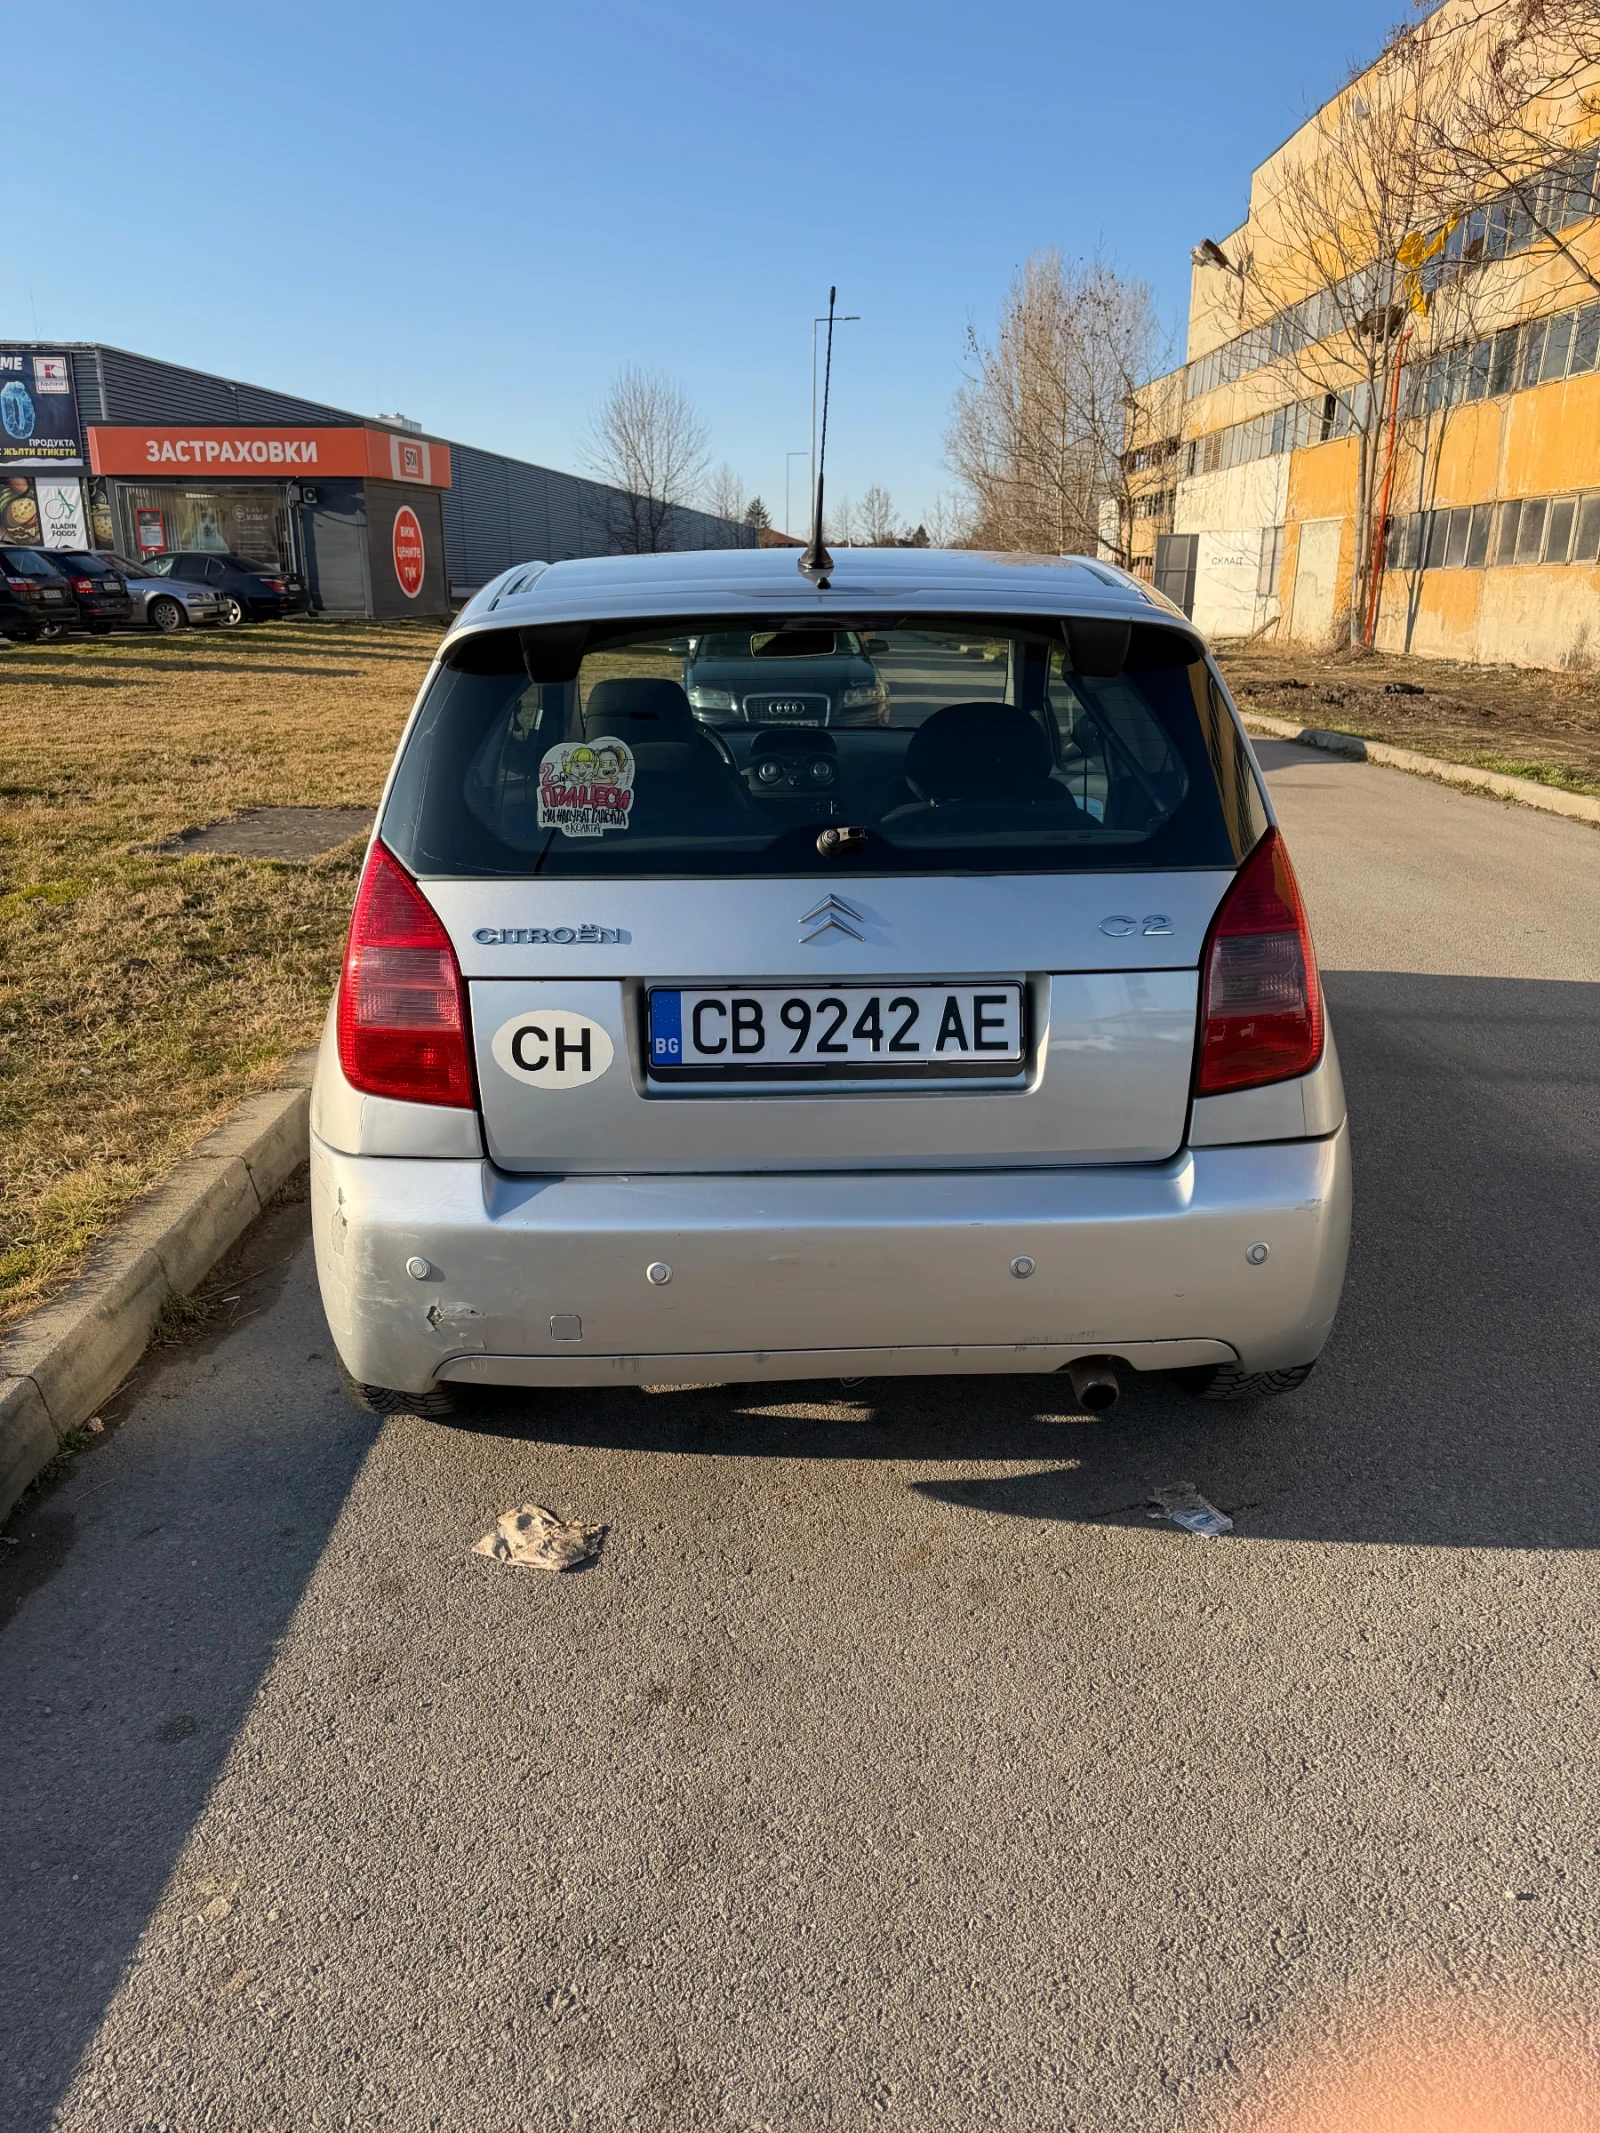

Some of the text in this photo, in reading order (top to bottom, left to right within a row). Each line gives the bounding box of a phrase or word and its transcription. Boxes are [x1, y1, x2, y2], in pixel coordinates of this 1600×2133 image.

[3, 447, 36, 456] ЖЪЛТИ
[37, 447, 77, 456] ЕТИКЕТИ
[28, 438, 76, 447] ПРОДУКТА
[145, 440, 318, 463] ЗАСТРАХОВКИ
[1211, 557, 1245, 566] СКЛАД
[404, 566, 417, 582] тук
[541, 785, 630, 810] ПРИНЦЕСИ
[471, 924, 622, 945] CITROËN
[1099, 914, 1176, 938] C2
[692, 994, 1009, 1055] CB 9242 AE
[510, 1026, 592, 1072] CH
[655, 1037, 679, 1055] BG
